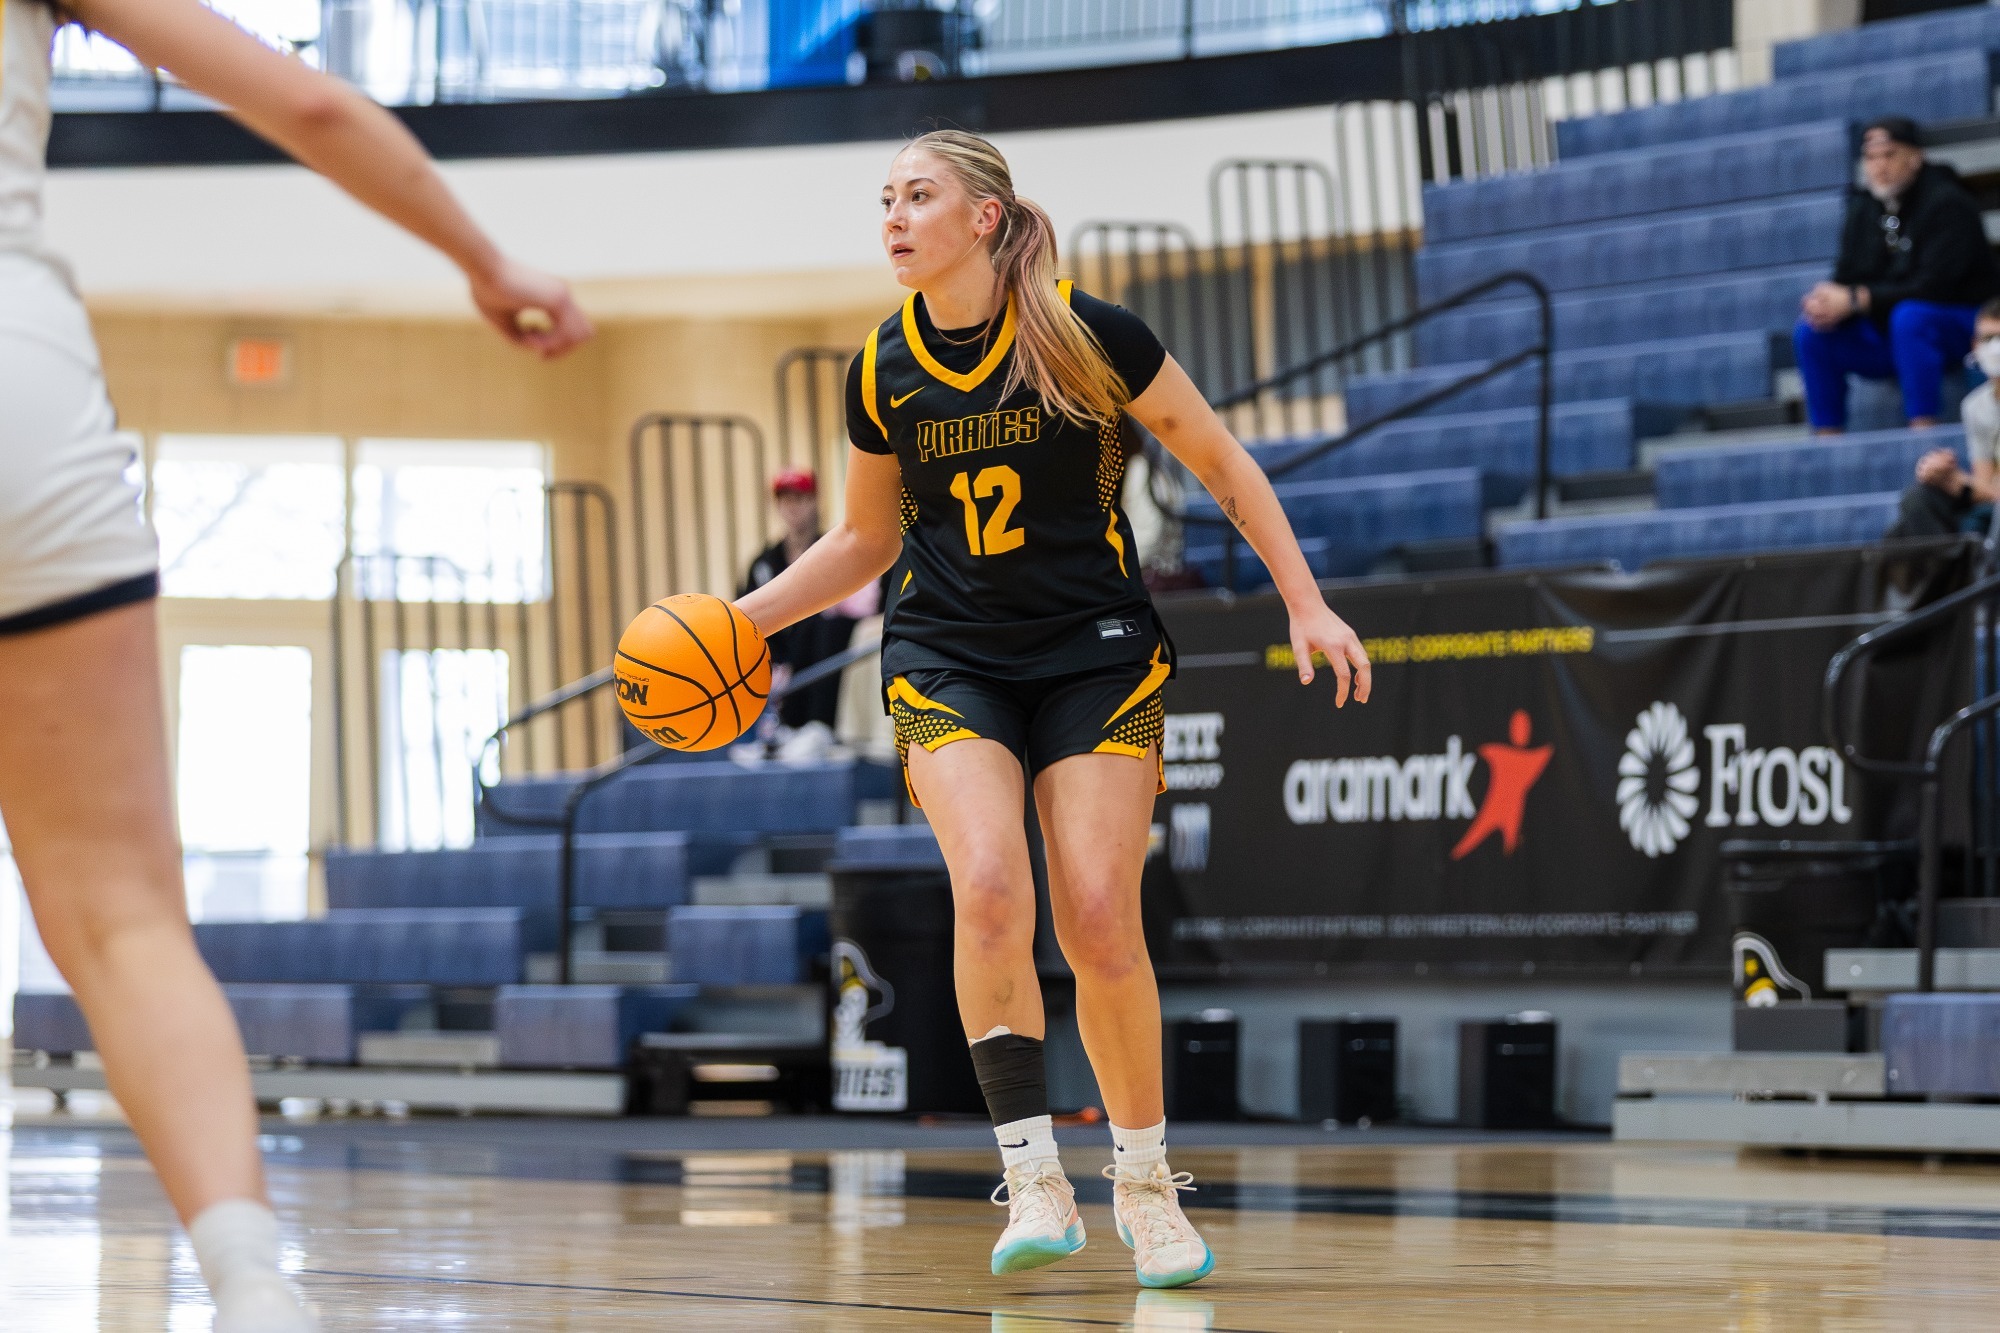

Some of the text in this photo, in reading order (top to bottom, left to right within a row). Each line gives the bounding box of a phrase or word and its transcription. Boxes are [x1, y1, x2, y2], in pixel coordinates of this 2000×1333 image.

[917, 406, 1041, 462] PIRATES
[949, 464, 1025, 556] 12
[614, 673, 649, 706] NCA
[1283, 734, 1477, 825] aramark
[1703, 723, 1852, 827] Frost
